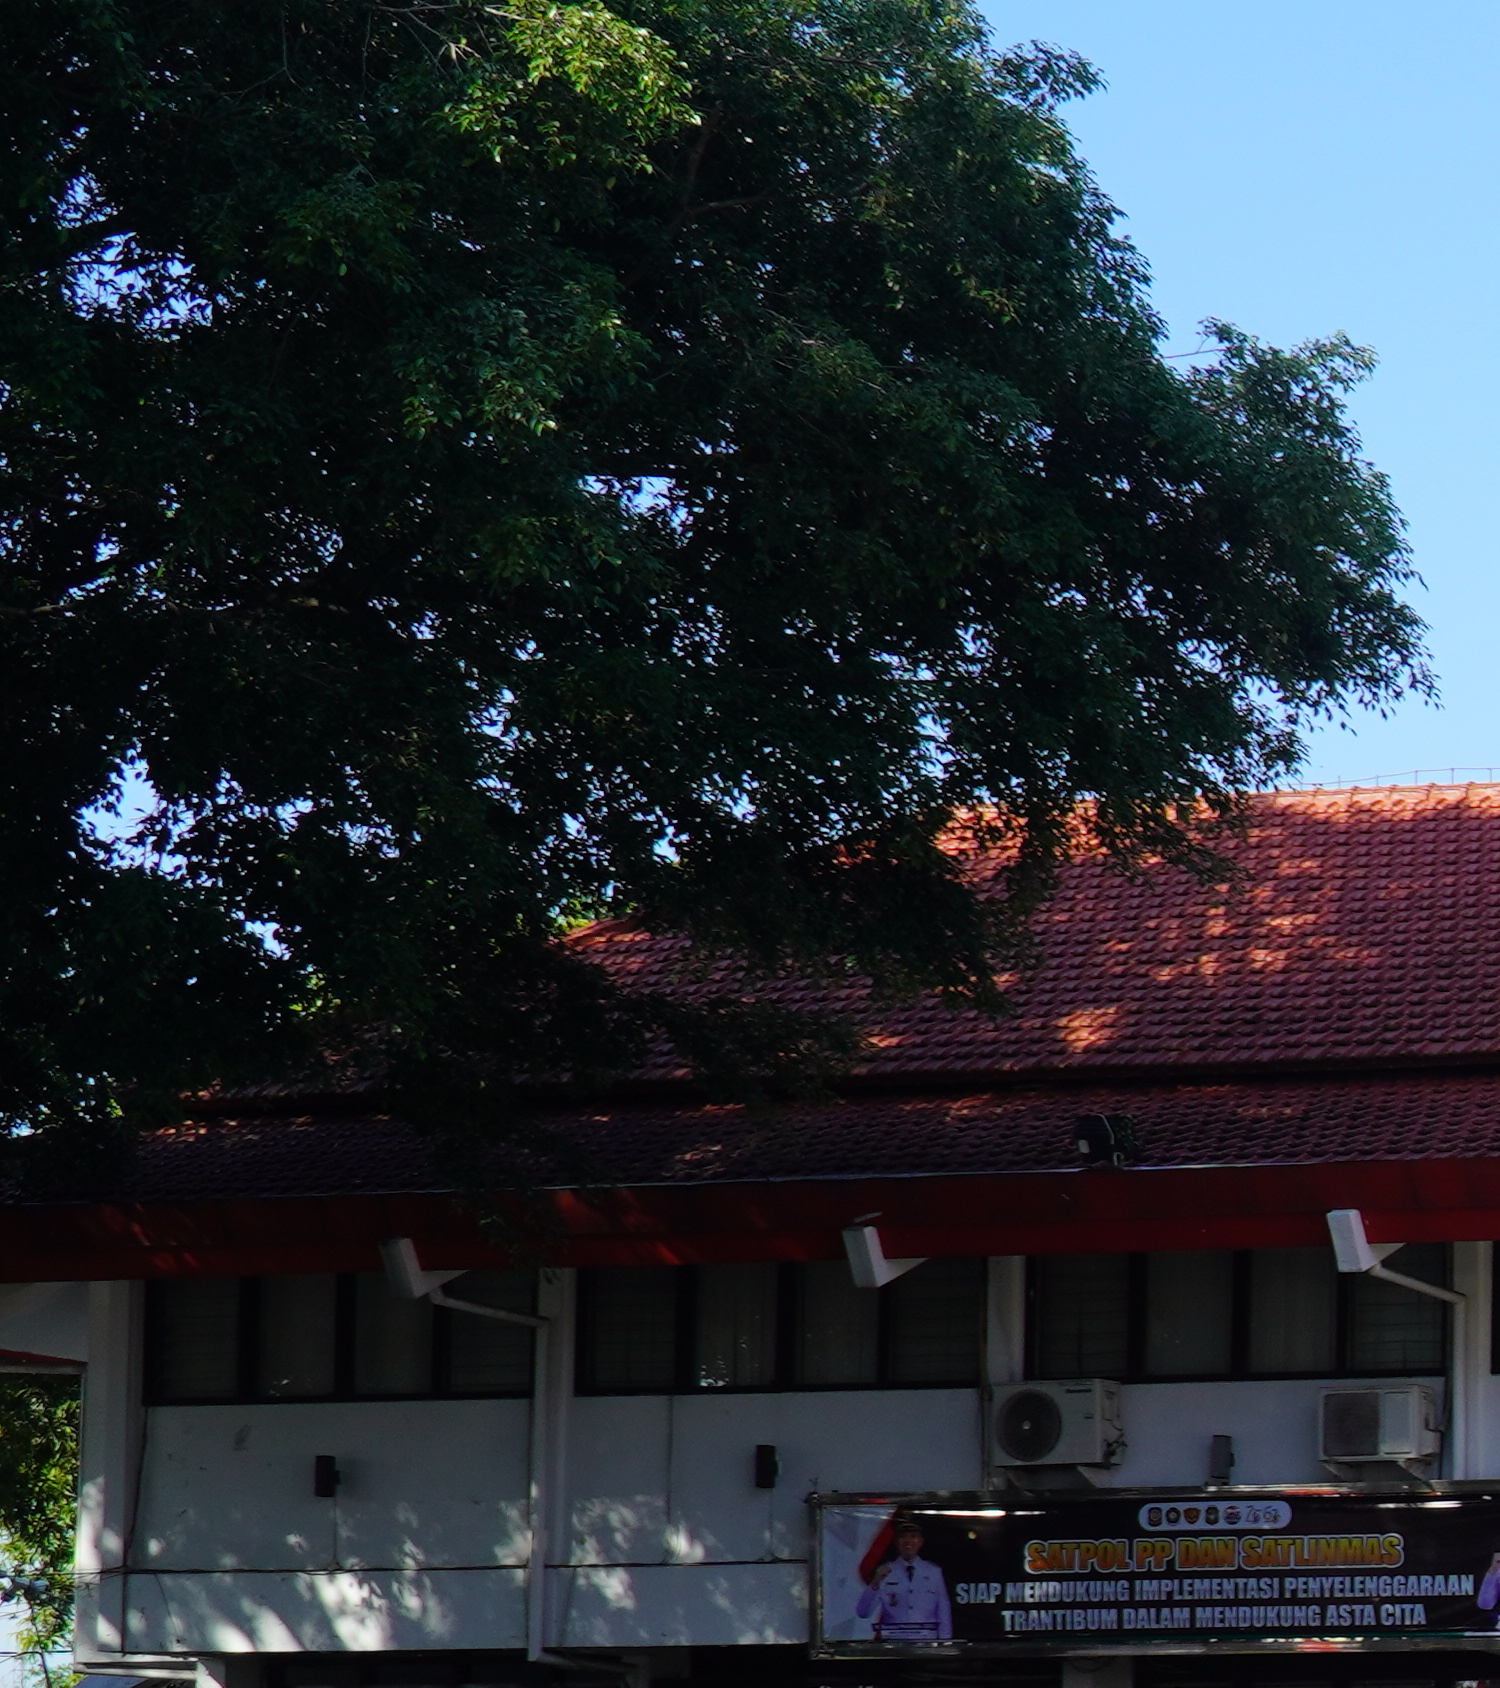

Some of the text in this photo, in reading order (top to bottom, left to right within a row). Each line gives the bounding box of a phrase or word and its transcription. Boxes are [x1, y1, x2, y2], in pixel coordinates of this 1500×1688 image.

[1024, 1533, 1404, 1574] SATPOL PP DAN SATLINMAS
[956, 1574, 1475, 1604] SIAP MENDUKUNG IMPLEMENTASI PENYELENGGARAAN
[1001, 1603, 1427, 1631] TRANTIBUM DALAM MENDUKUNG ASTA CITA
